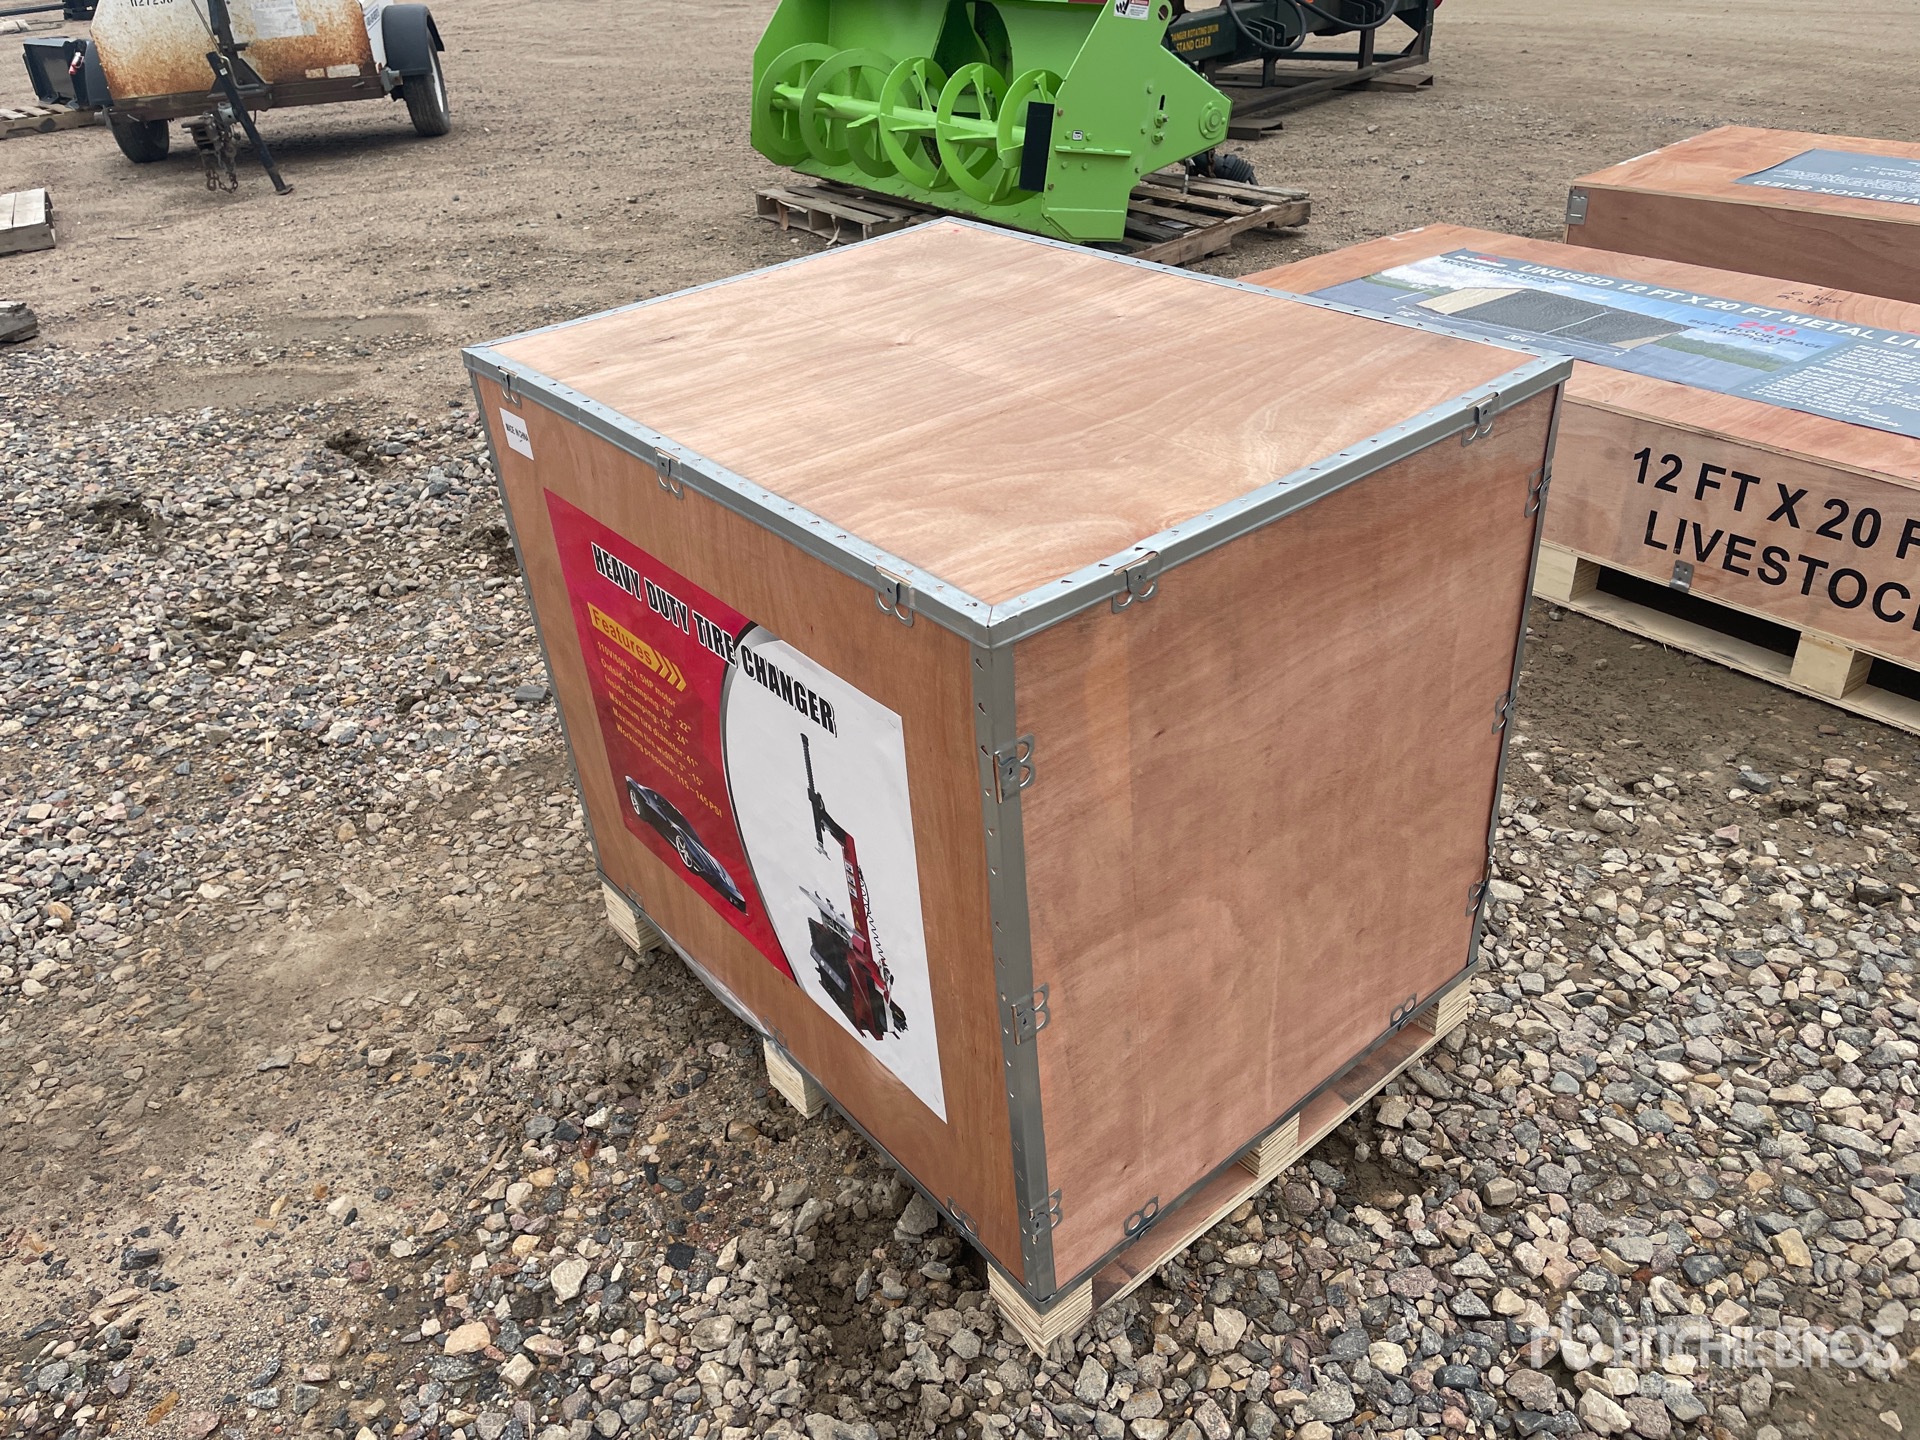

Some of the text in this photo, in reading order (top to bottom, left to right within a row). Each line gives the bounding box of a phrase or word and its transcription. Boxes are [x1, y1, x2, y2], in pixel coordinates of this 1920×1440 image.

[1176, 36, 1211, 52] STAND CLEAR
[1753, 180, 1813, 191] SHED
[1519, 264, 1615, 287] UNUSED
[1617, 283, 1648, 293] 12
[1646, 288, 1686, 300] FT
[1681, 295, 1709, 305] X
[1704, 300, 1741, 311] 20
[1741, 306, 1782, 319] FT
[1780, 314, 1875, 340] METAL
[1729, 327, 1775, 339] FLOOR
[1778, 337, 1826, 349] SPACE
[1736, 320, 1798, 337] 240
[1633, 447, 1683, 493] 12
[1694, 463, 1761, 512] FT
[1766, 483, 1808, 529] X
[1816, 499, 1882, 548] 20
[1643, 510, 1920, 632] LIVESTOC
[591, 542, 838, 738] HEAVY DUTY TIRE CHANGER
[592, 608, 653, 666] Features
[600, 658, 627, 685] Outside
[604, 673, 626, 696] Inside
[608, 690, 640, 722] Maximum
[655, 687, 676, 708] motor
[612, 706, 644, 738] Maximum
[615, 722, 644, 753] Working
